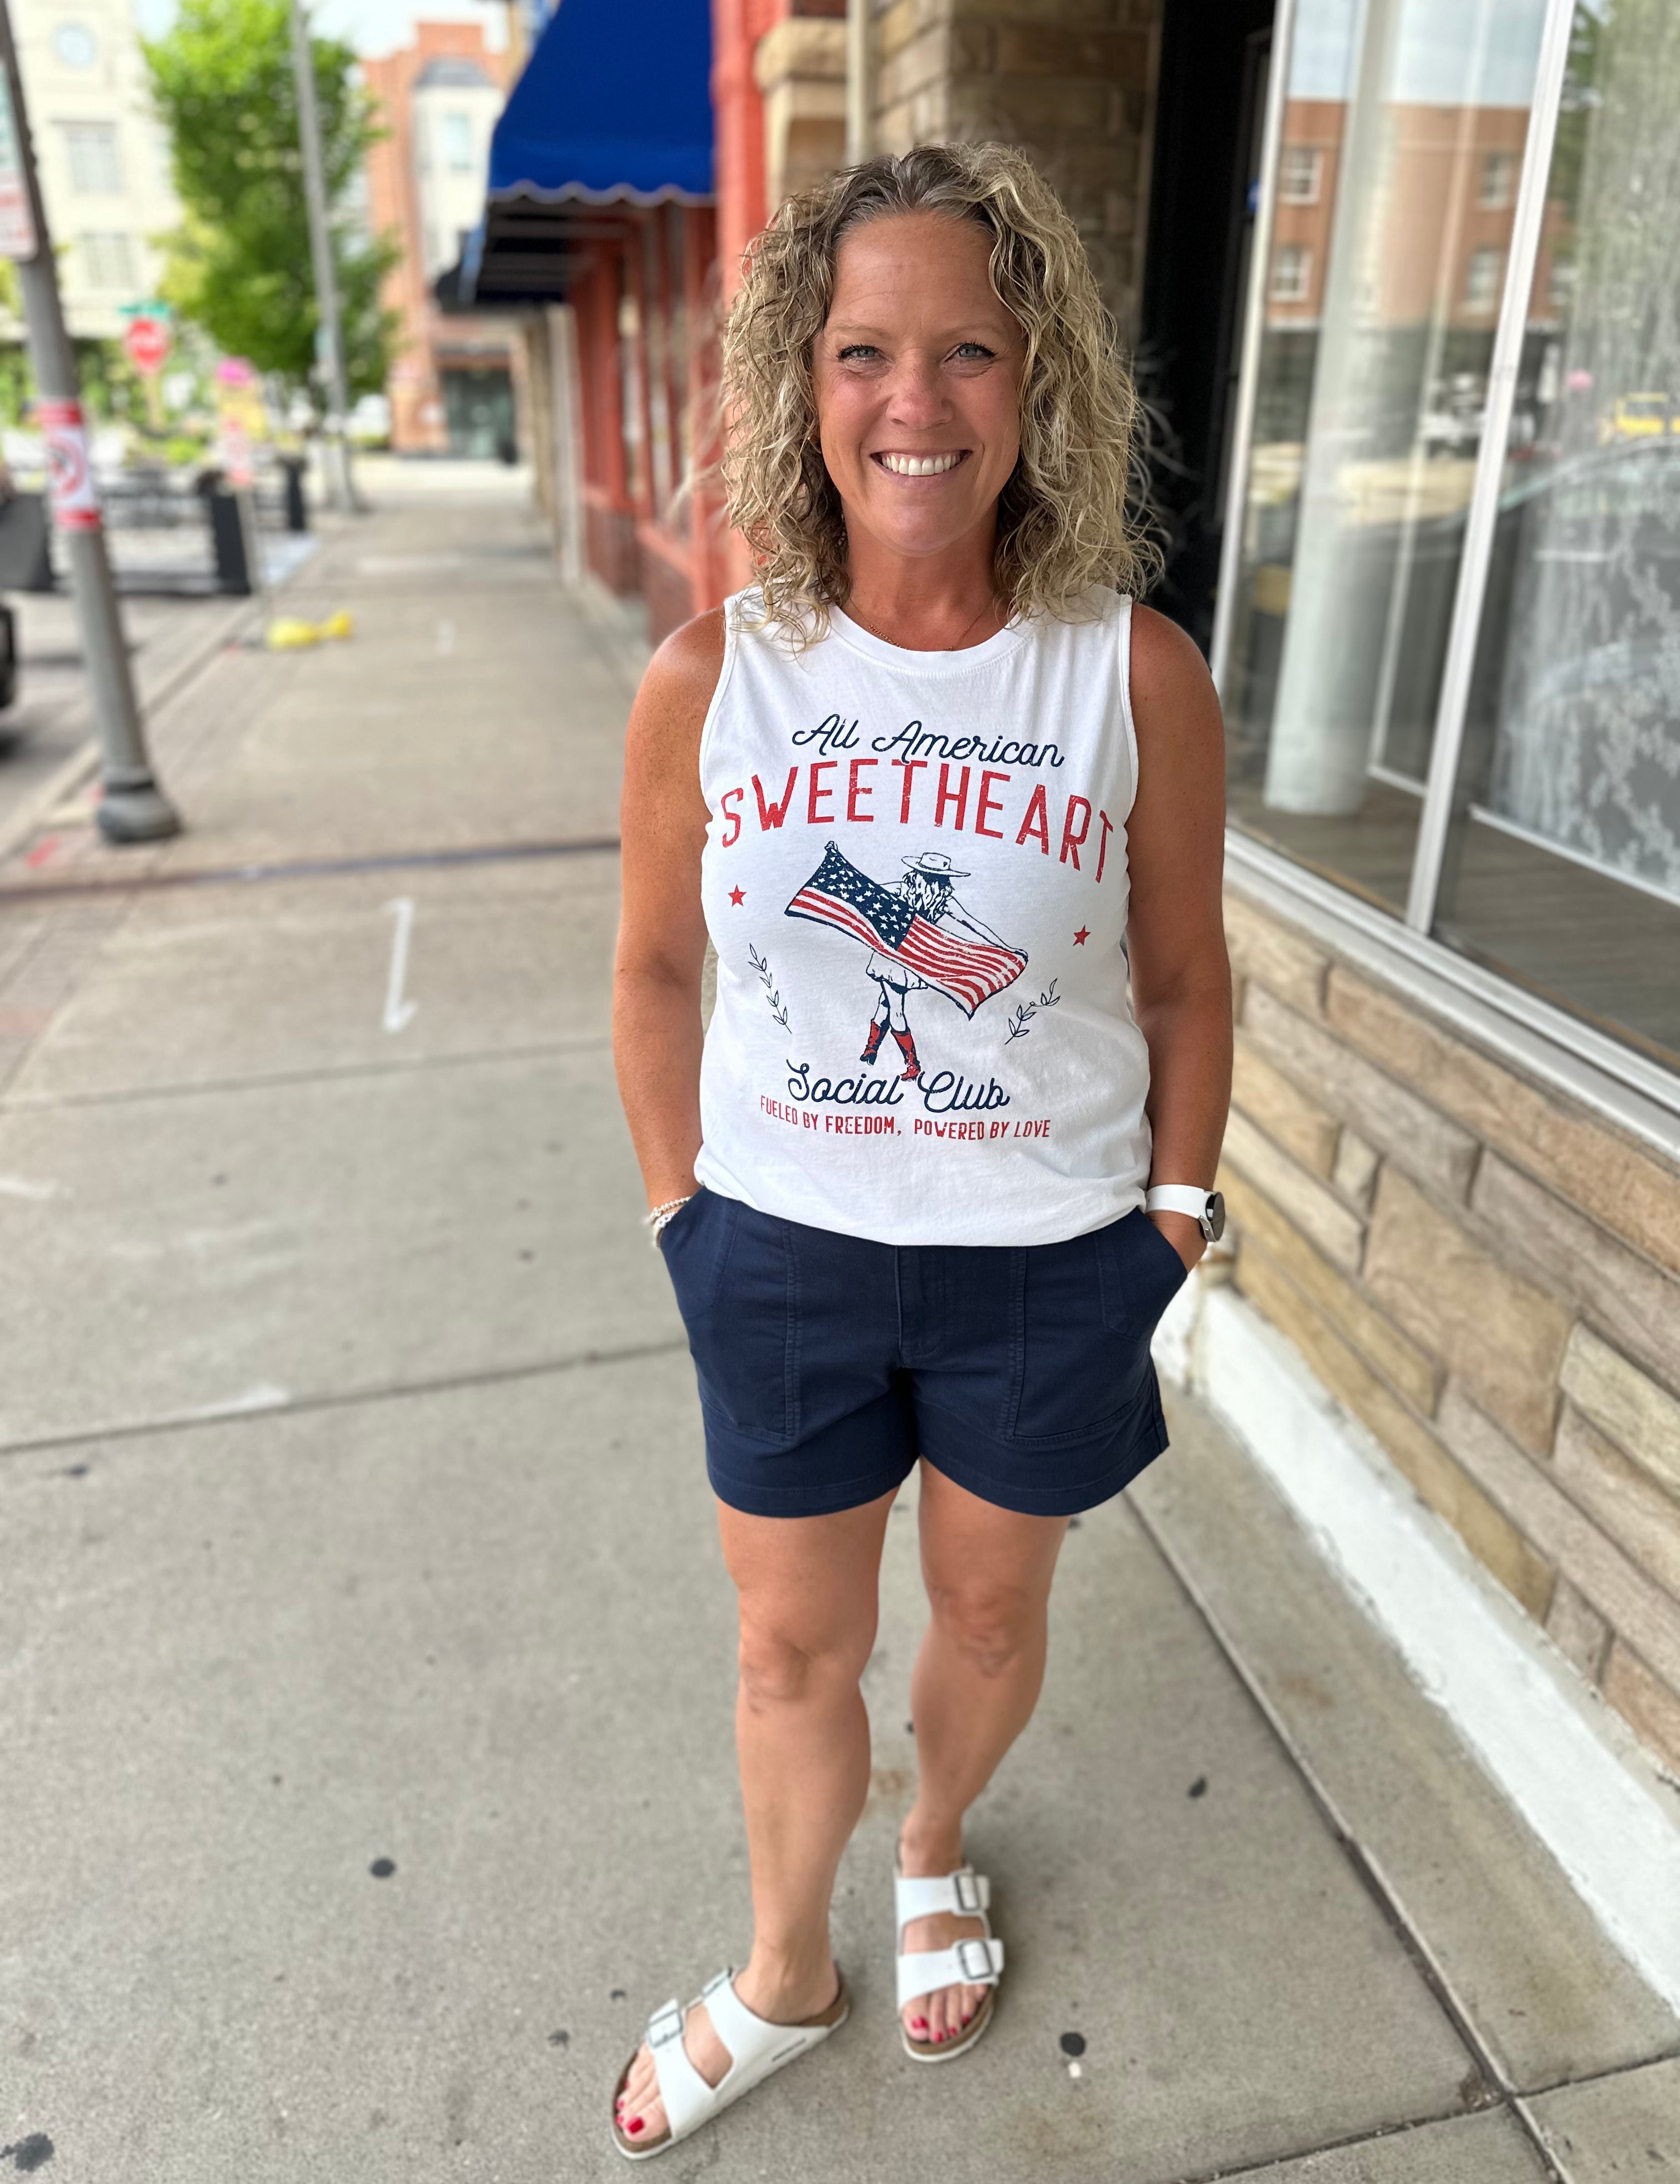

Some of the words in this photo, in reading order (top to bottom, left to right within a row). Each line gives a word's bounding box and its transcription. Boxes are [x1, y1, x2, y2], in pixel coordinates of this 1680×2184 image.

[791, 713, 861, 756] All
[871, 720, 1066, 768] American
[721, 757, 1114, 884] SWEETHEART
[786, 1058, 904, 1106] Social
[917, 1070, 1011, 1113] Club
[759, 1095, 798, 1126] FUELED
[802, 1112, 819, 1129] BY
[825, 1116, 902, 1137] FREEDOM,
[914, 1118, 986, 1141] POWERED
[989, 1121, 1010, 1138] BY
[1013, 1120, 1051, 1138] LOVE
